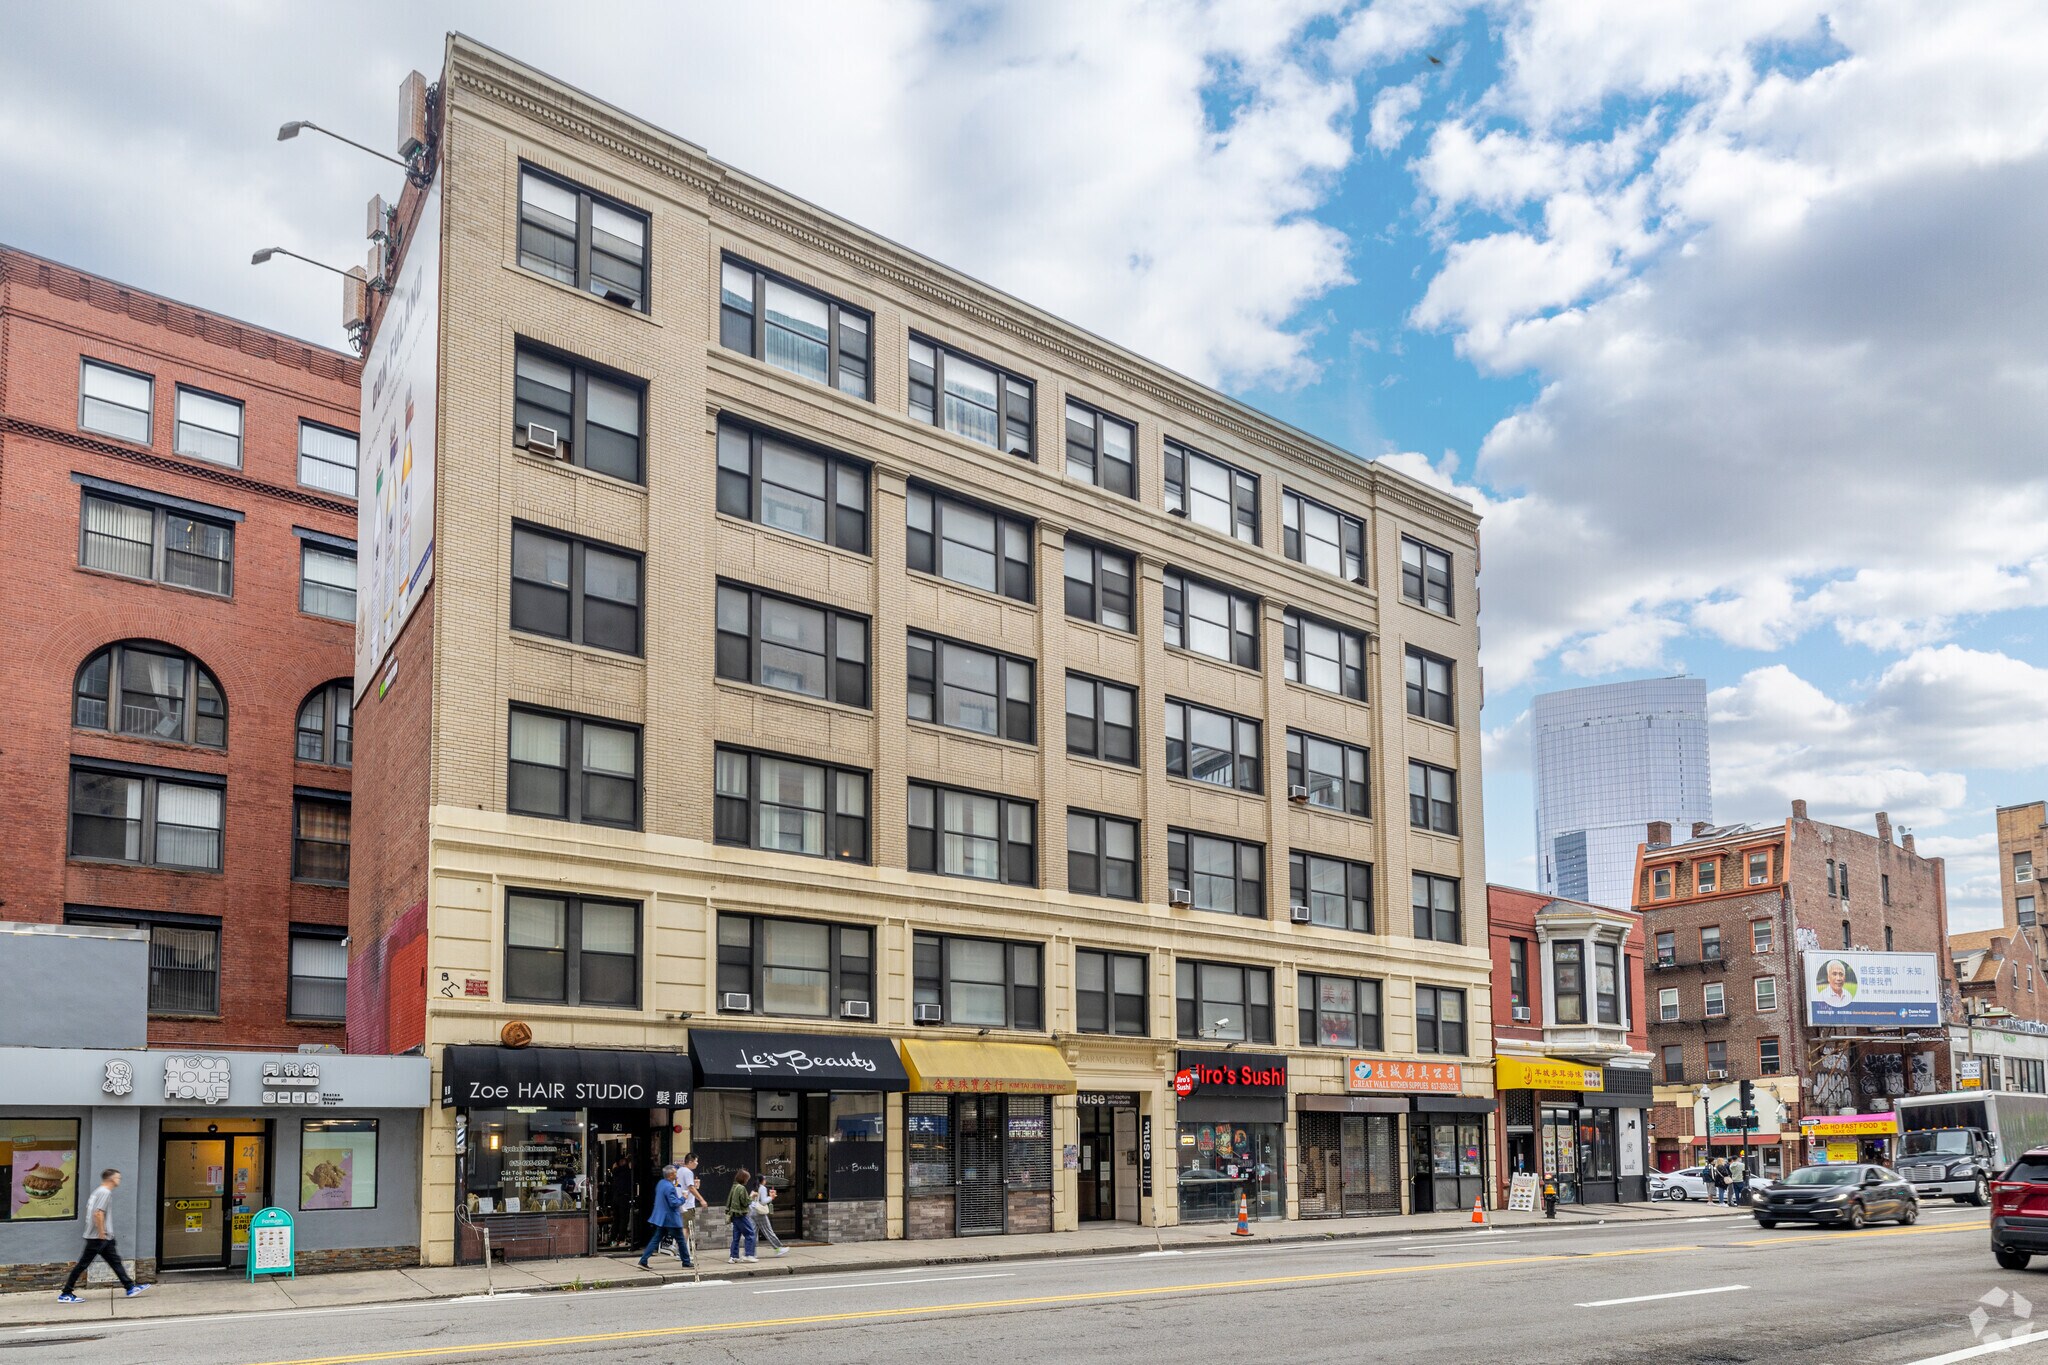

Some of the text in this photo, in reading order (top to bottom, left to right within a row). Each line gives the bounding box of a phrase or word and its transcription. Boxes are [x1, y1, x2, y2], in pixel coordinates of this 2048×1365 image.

[372, 263, 422, 413] DON FULANO
[736, 1049, 877, 1075] Le's Beauty
[1080, 1055, 1149, 1065] GARMENT CENTRE
[1241, 1065, 1285, 1086] Sushi
[1353, 1080, 1374, 1088] GREAT
[1374, 1080, 1389, 1088] WALL
[1390, 1081, 1408, 1089] KITCHEN
[1409, 1082, 1428, 1090] SUPPLIES
[470, 1082, 509, 1098] Zoe
[518, 1082, 565, 1098] HAIR
[576, 1083, 644, 1100] STUDIO
[770, 1104, 784, 1112] 26
[1841, 1122, 1857, 1130] FAST
[852, 1163, 879, 1172] Beauty
